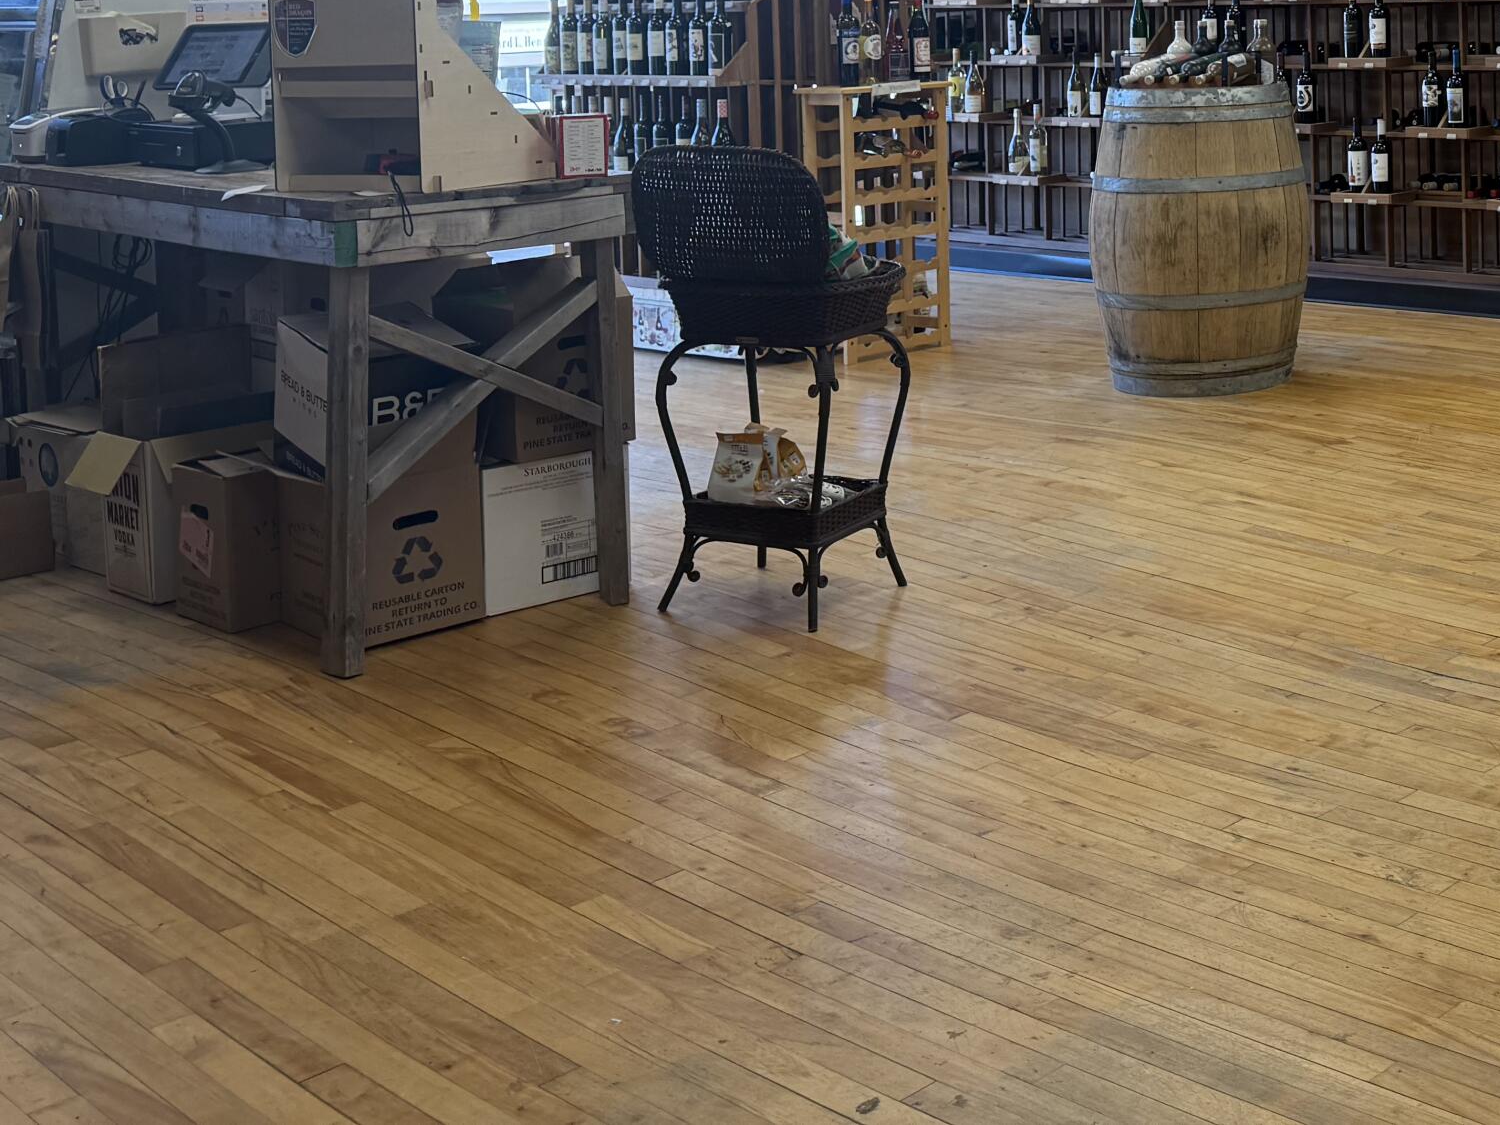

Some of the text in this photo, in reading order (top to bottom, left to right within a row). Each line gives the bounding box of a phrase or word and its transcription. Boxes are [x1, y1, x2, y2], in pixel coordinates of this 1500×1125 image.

[306, 390, 329, 413] BUTTE
[372, 387, 447, 426] B&
[523, 438, 545, 451] PINE
[547, 432, 574, 446] STATE
[523, 457, 591, 477] STARBOROUGH
[111, 473, 140, 508] ION
[107, 500, 139, 531] MARKET
[114, 527, 136, 547] VODKA
[372, 581, 465, 611] REUSABLE CARTON
[391, 596, 448, 618] RETURN TO
[365, 624, 385, 637] INE
[384, 617, 414, 632] STATE
[418, 606, 461, 623] TRADING
